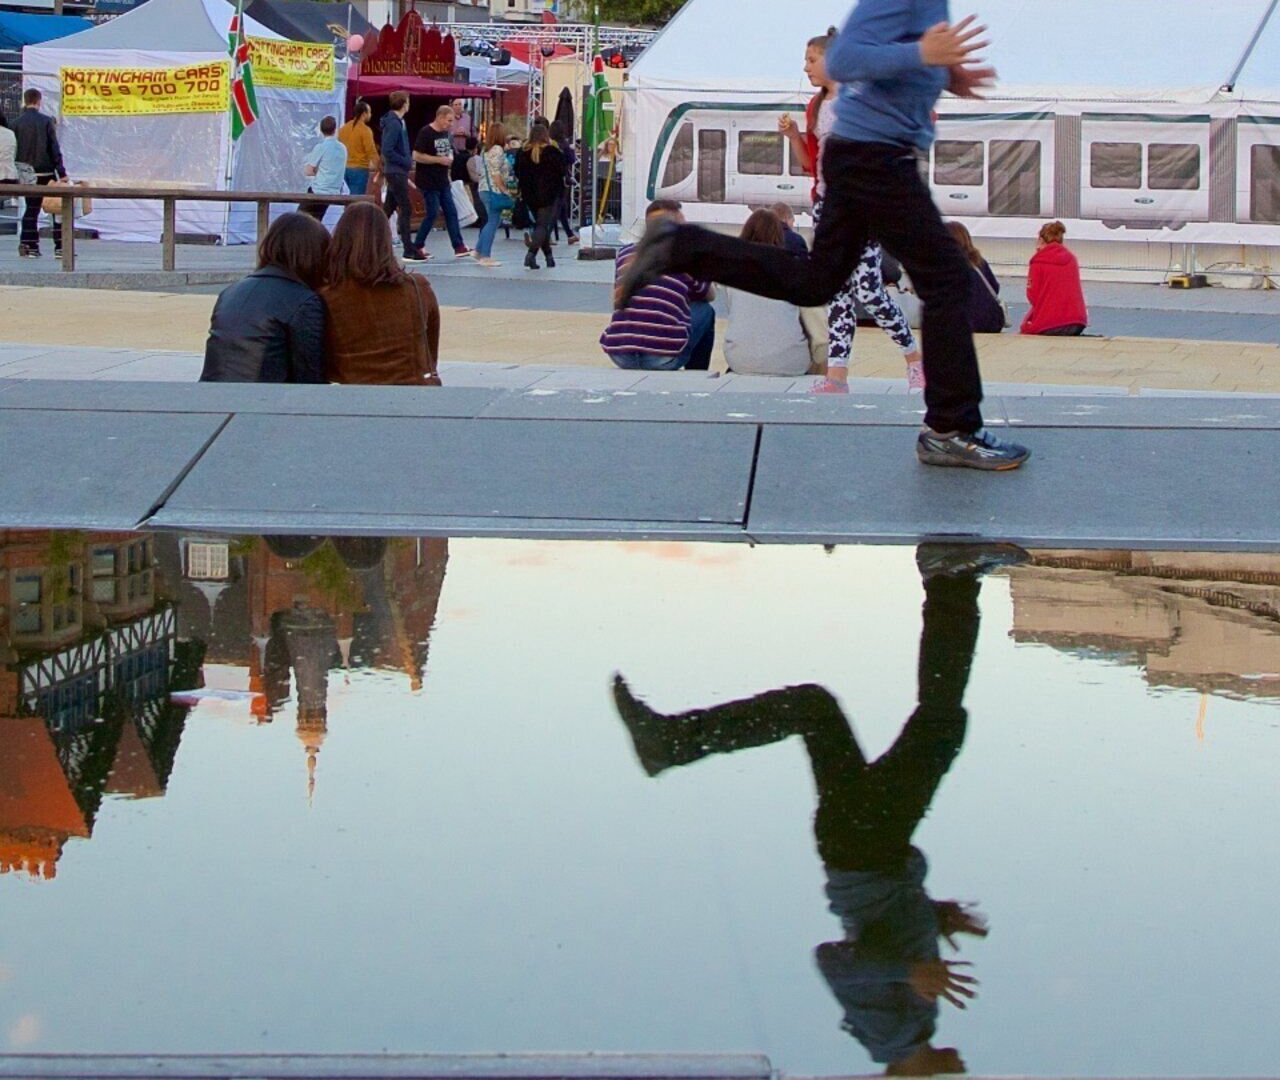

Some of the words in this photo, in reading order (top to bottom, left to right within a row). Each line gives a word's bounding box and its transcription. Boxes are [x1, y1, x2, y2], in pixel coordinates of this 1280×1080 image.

[65, 70, 167, 84] NOTTINGHAM
[174, 66, 222, 81] CARS
[65, 84, 112, 97] 0115
[120, 85, 131, 96] 9
[137, 84, 176, 95] 700
[184, 80, 220, 93] 700
